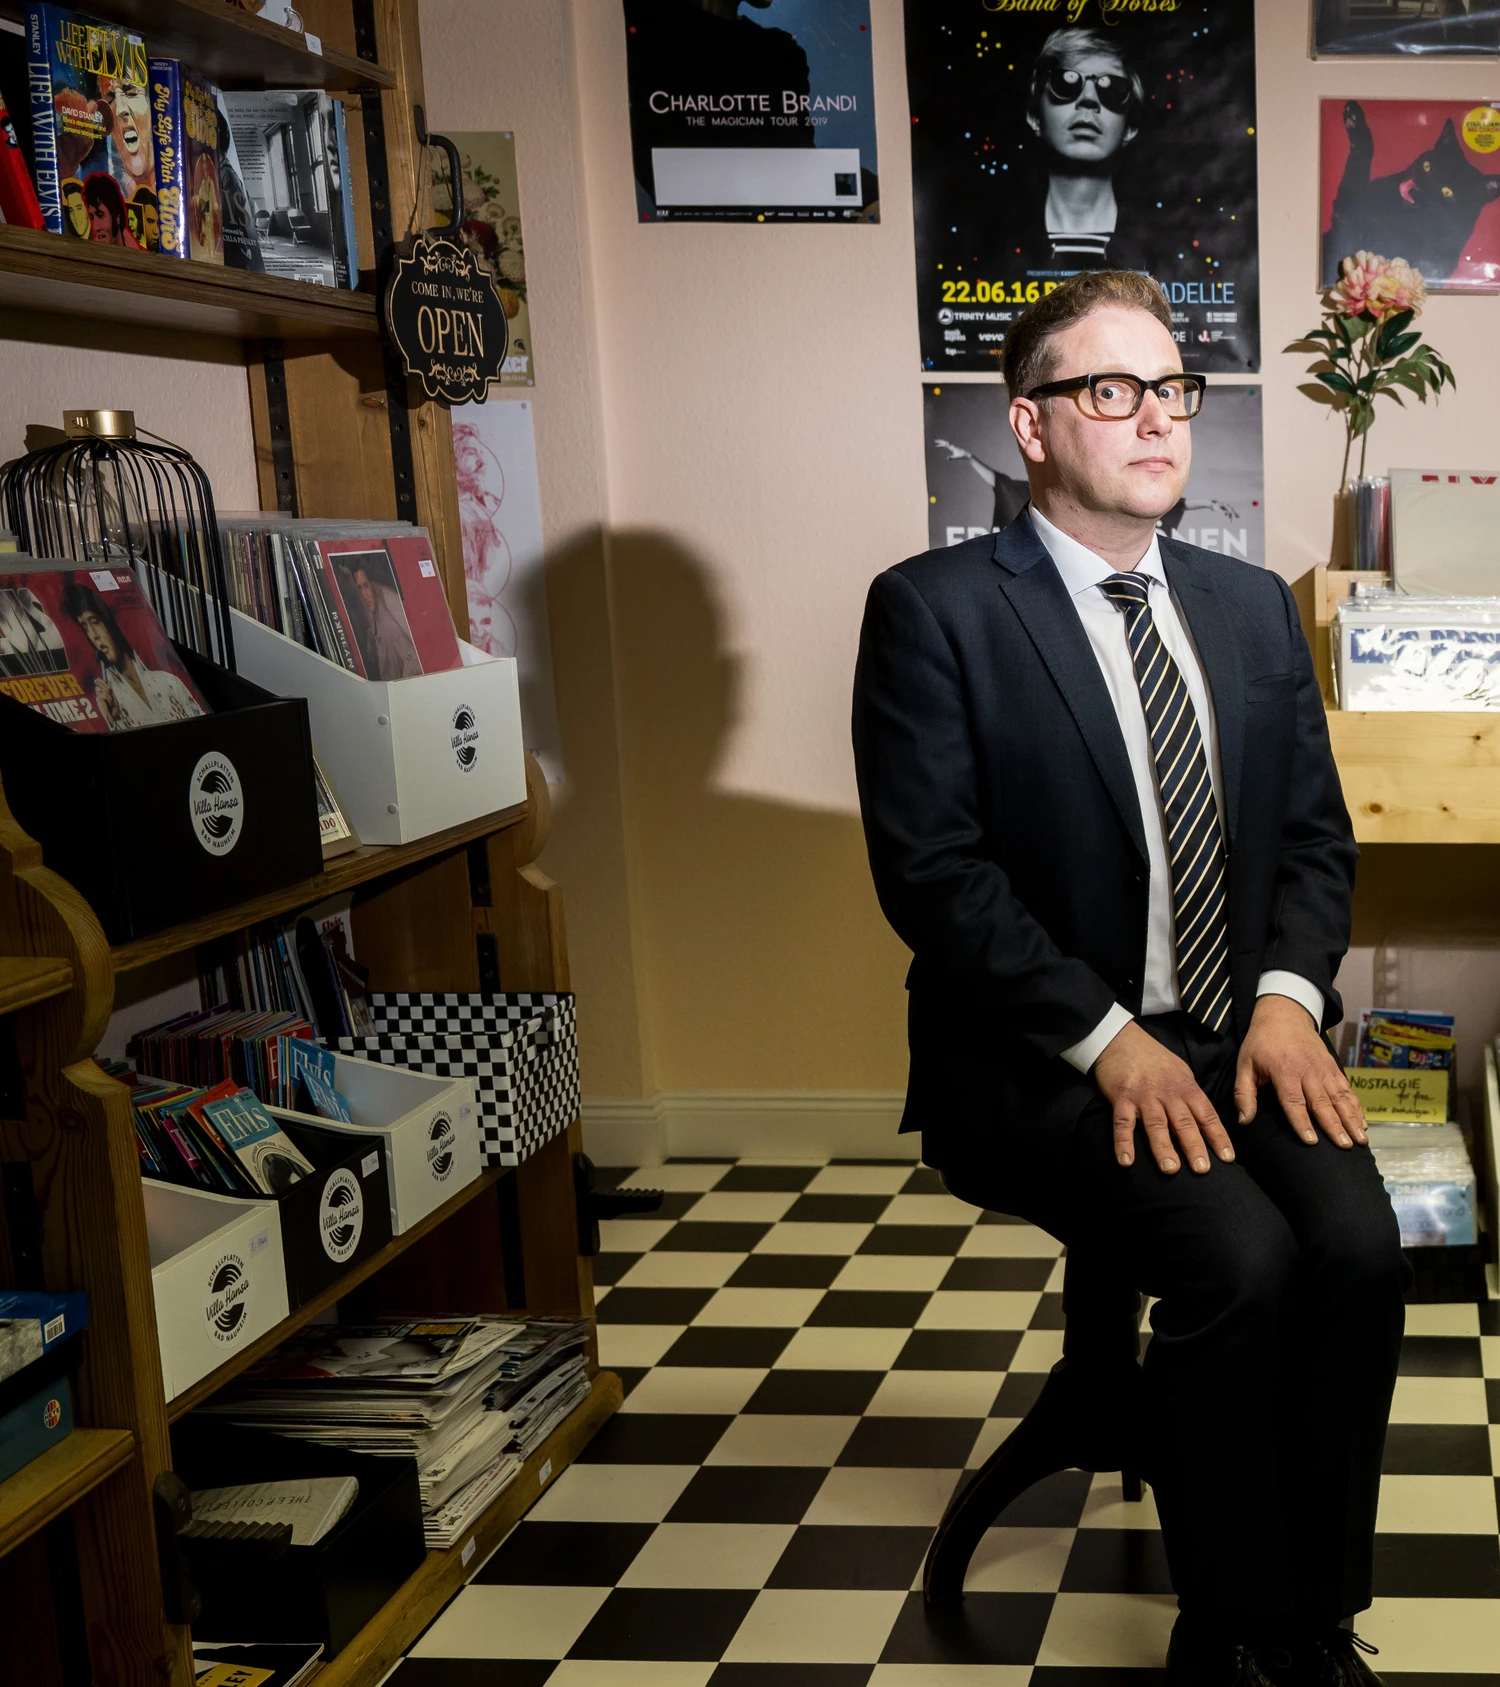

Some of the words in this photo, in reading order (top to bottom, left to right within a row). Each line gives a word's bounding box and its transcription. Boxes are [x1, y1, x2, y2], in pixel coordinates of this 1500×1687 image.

[30, 13, 41, 55] STANLEY
[60, 20, 87, 48] LIFE
[55, 41, 90, 71] WITH
[85, 25, 148, 88] ELVIS
[28, 62, 53, 104] LIFE
[153, 83, 170, 112] My
[649, 91, 770, 114] CHARLOTTE
[783, 90, 857, 114] BRANDI
[61, 106, 78, 117] DAVID
[79, 109, 104, 123] STANLEY
[686, 116, 706, 126] THE
[712, 116, 764, 126] MAGICIAN
[770, 116, 799, 126] TOUR
[805, 116, 828, 126] 2019
[32, 109, 57, 162] WITH
[152, 113, 174, 146] Life
[160, 147, 176, 183] With
[36, 169, 61, 217] ELVIS
[158, 186, 181, 253] Elvis
[411, 281, 439, 297] COME
[456, 287, 484, 303] WE'RE
[942, 281, 1040, 303] 22.06.16
[1161, 281, 1235, 304] ADELLE
[953, 312, 985, 320] TRINITY
[986, 312, 1013, 320] MUSIC
[417, 305, 484, 358] OPEN
[978, 333, 1005, 341] vevo
[116, 575, 132, 583] RCA
[80, 697, 98, 719] 2
[450, 734, 463, 749] Villa
[463, 731, 479, 745] Hansa
[197, 760, 235, 784] SCHALLPLATTEN
[193, 798, 213, 816] Villa
[213, 795, 239, 813] Hansa
[201, 828, 211, 844] BAD
[212, 828, 236, 848] NAUHEIM
[1350, 1076, 1421, 1091] NOSTALGIE
[212, 1102, 270, 1143] Elvis
[325, 1176, 357, 1200] SCHALLPLATTEN
[322, 1212, 338, 1231] Villa
[338, 1205, 360, 1224] Hansa
[328, 1241, 336, 1254] BAD
[337, 1235, 357, 1256] NAUHEIM
[207, 1254, 244, 1288] SCHALLPLATTEN
[205, 1298, 224, 1322] Villa
[225, 1279, 250, 1307] Hansa
[214, 1330, 224, 1341] BAD
[225, 1312, 248, 1342] NAUHEIM
[44, 1406, 61, 1421] HEYE
